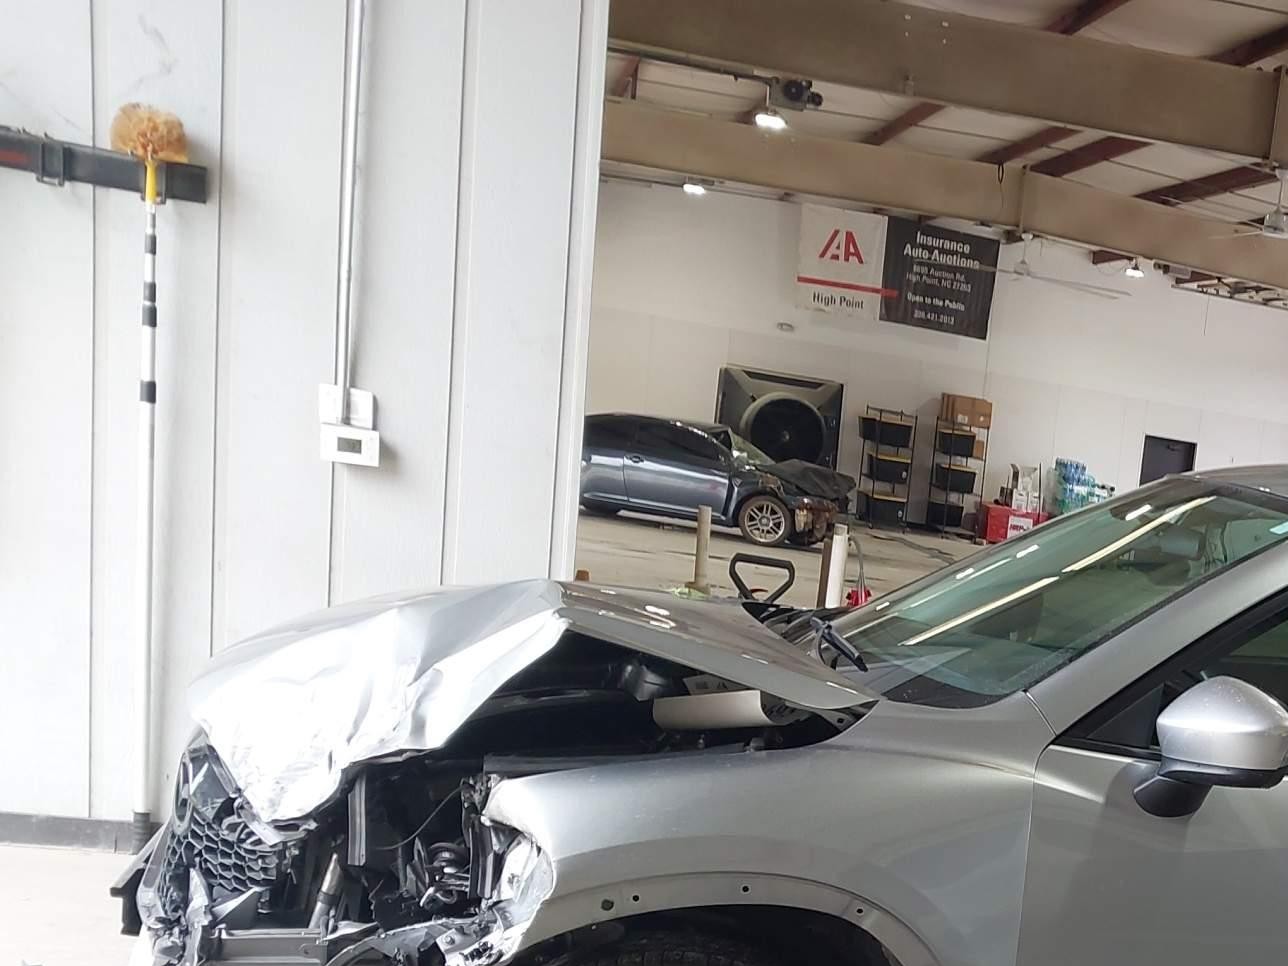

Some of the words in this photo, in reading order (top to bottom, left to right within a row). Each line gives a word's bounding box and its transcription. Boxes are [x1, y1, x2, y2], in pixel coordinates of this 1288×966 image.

[916, 230, 970, 254] Insurance
[903, 243, 929, 259] Auto
[931, 249, 980, 269] Auctions
[812, 291, 836, 307] High
[839, 295, 865, 310] Point
[907, 292, 924, 303] Open
[925, 296, 932, 304] to
[933, 297, 944, 307] the
